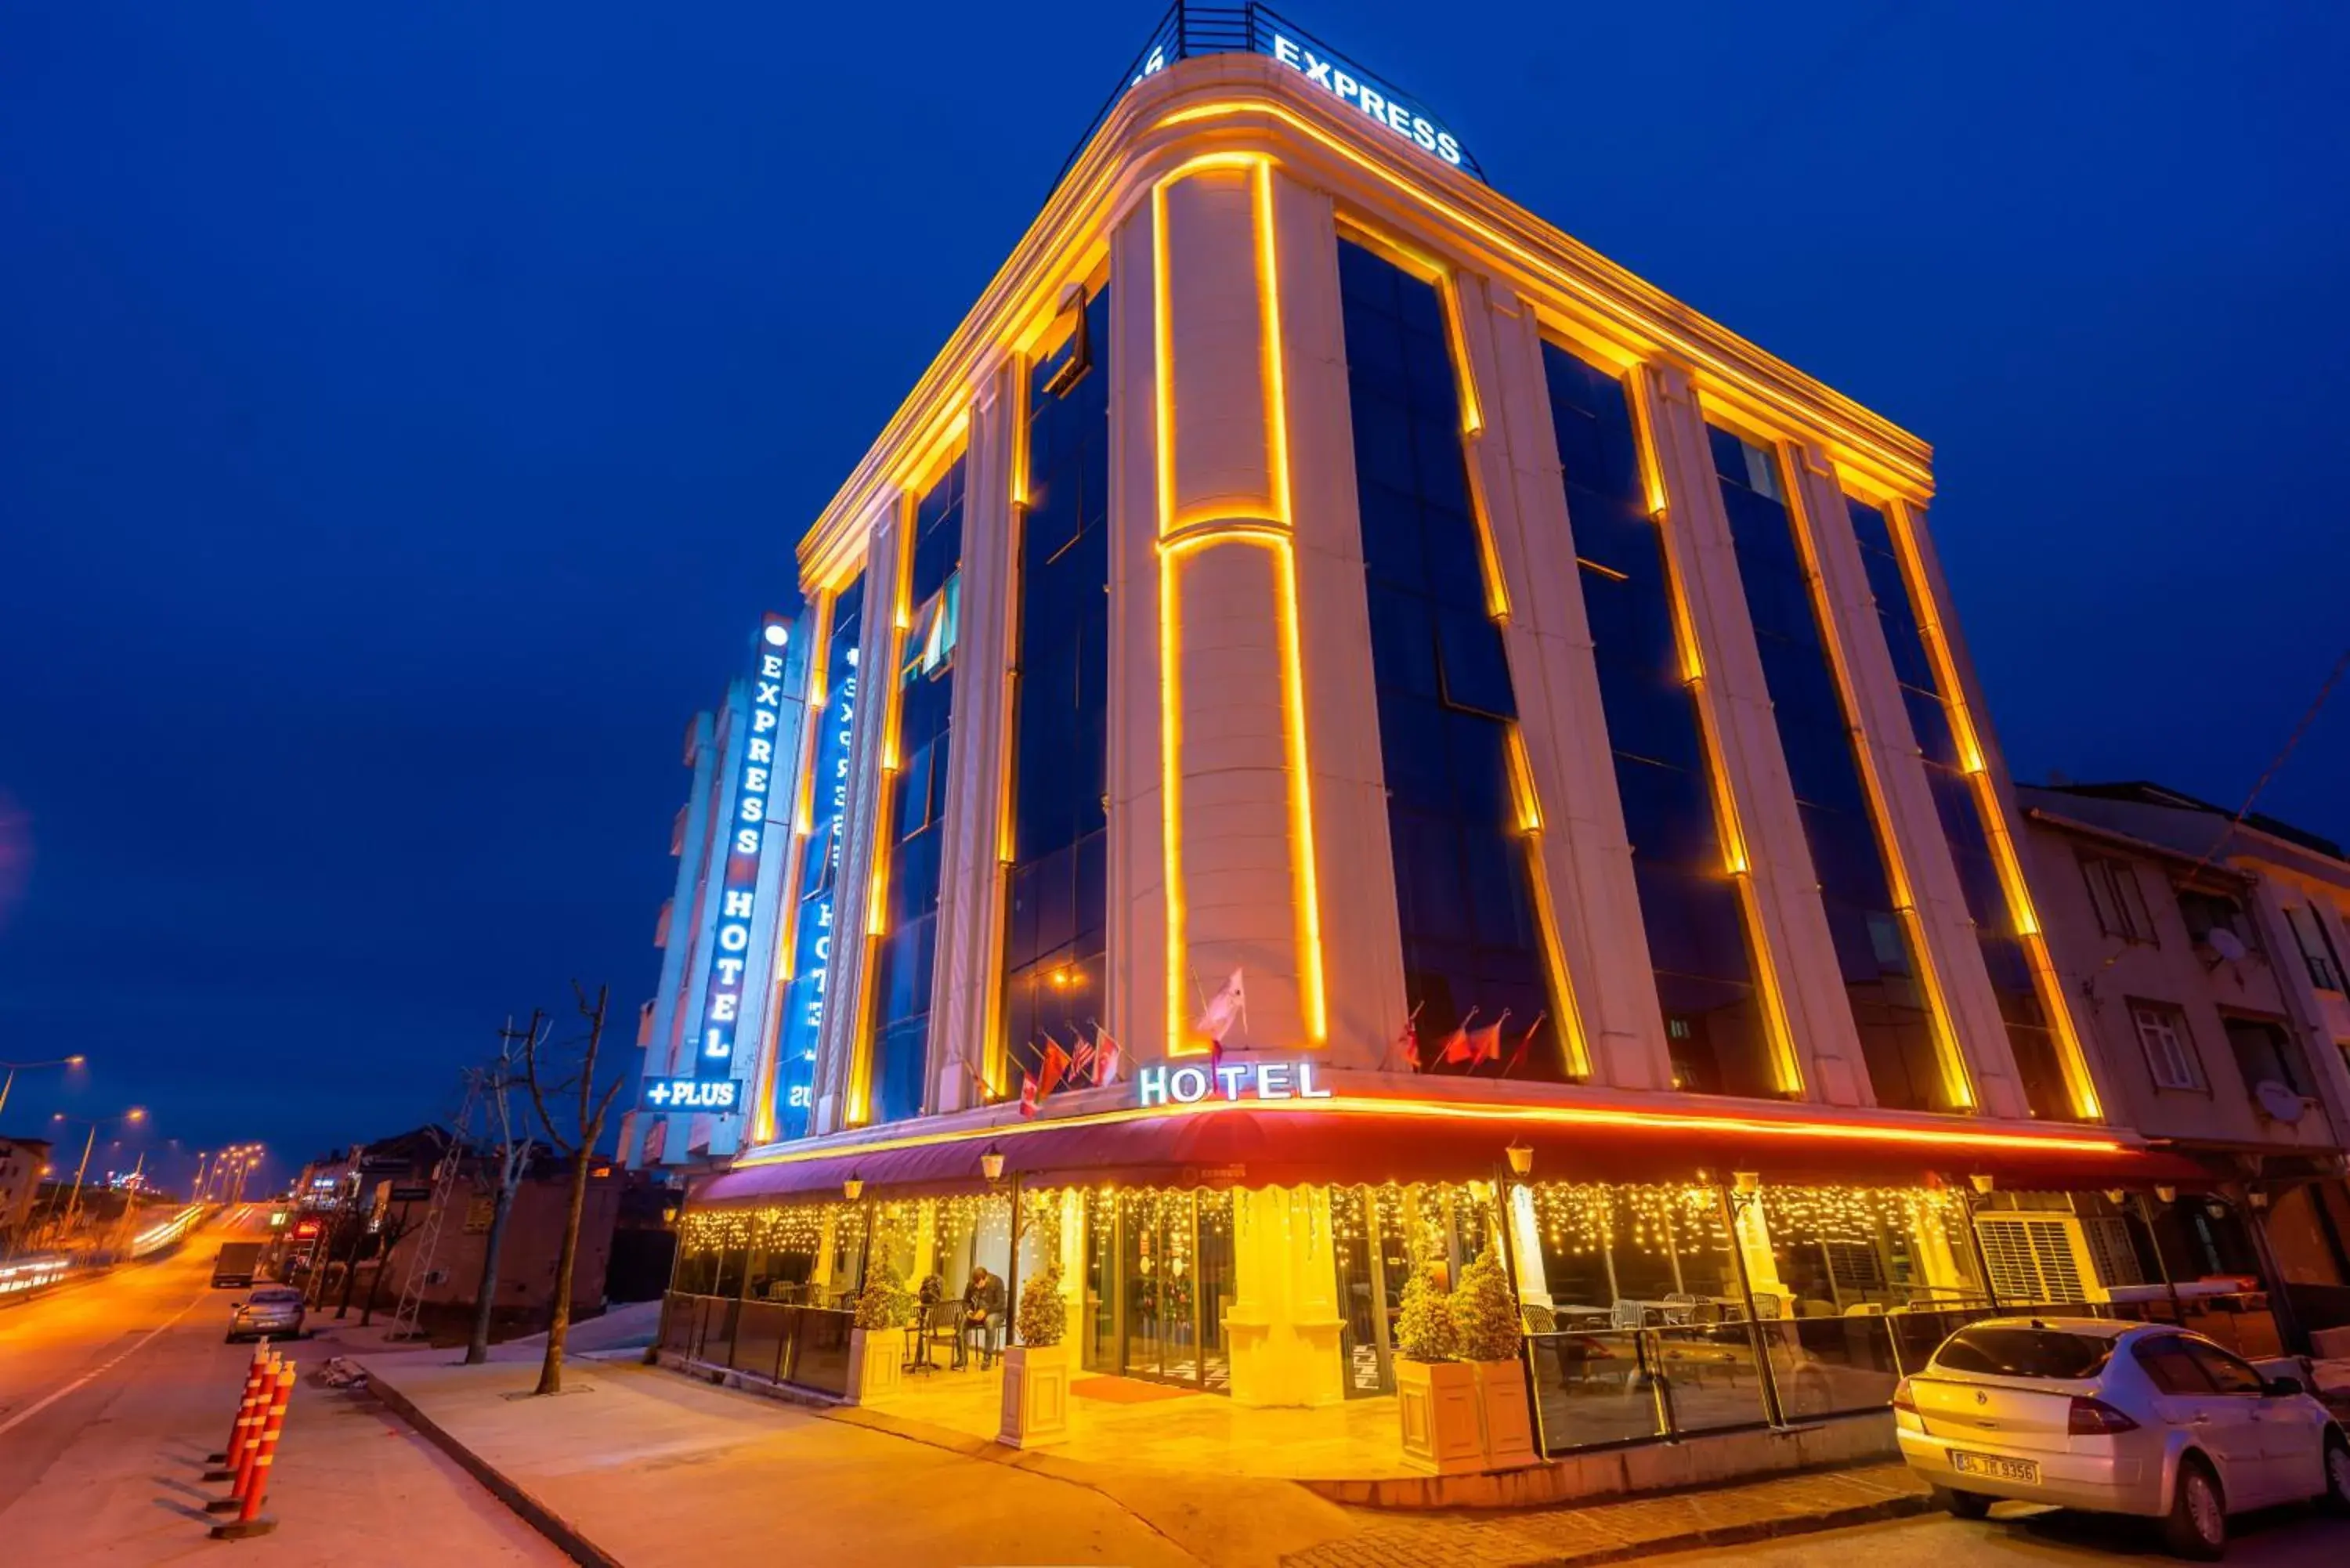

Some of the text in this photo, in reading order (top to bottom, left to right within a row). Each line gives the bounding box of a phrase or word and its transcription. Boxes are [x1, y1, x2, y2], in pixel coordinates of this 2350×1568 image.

[1274, 34, 1461, 165] EXPRESS
[706, 653, 783, 1058] EXPRESS HOTEL
[1140, 1063, 1331, 1106] HOTEL
